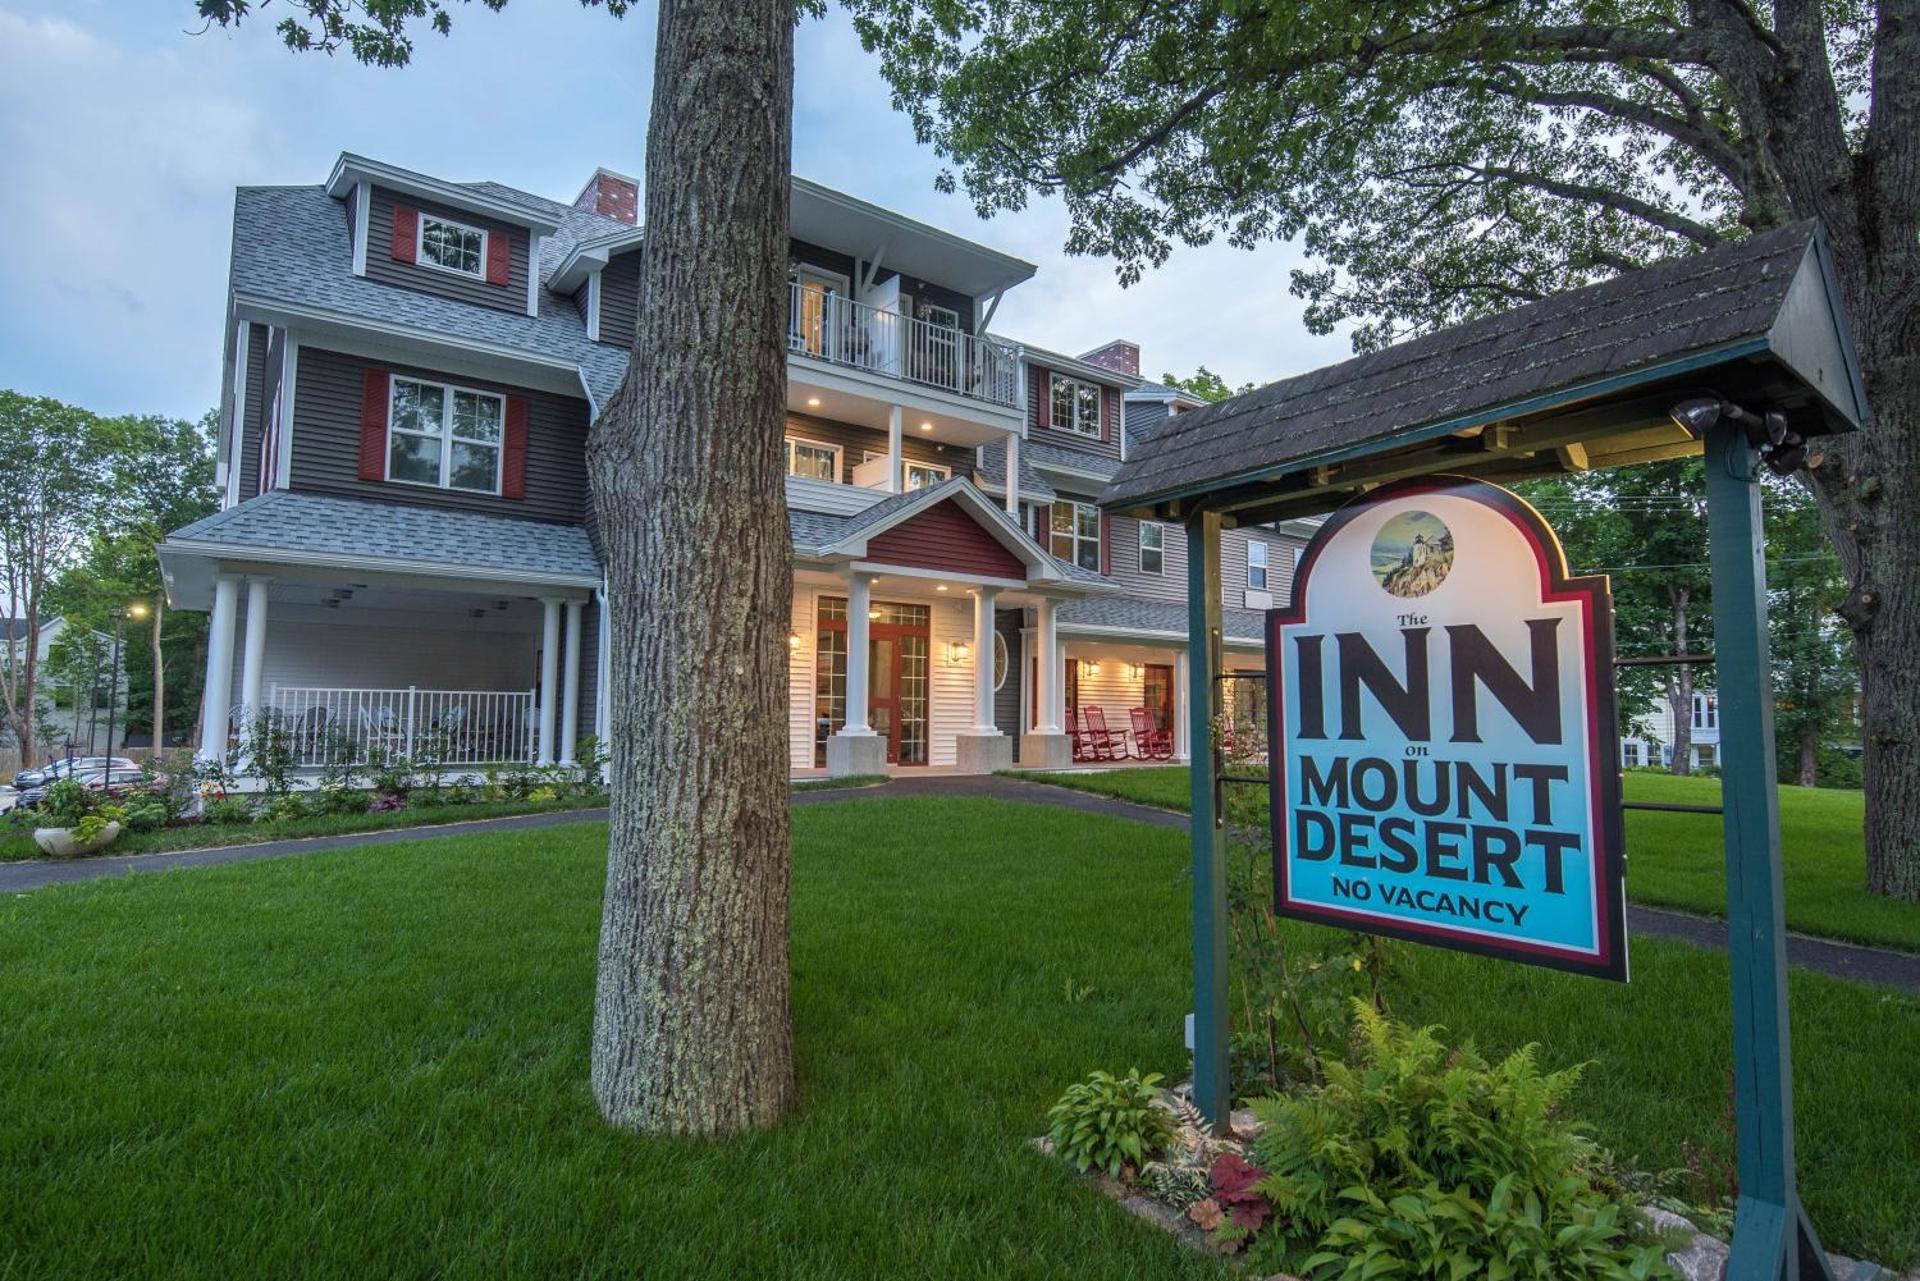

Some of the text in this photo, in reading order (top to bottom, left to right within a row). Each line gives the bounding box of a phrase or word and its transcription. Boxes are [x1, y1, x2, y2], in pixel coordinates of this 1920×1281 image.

[1397, 612, 1428, 627] The
[1294, 617, 1563, 745] INN
[1405, 744, 1430, 757] on
[1299, 755, 1569, 826] MOUNT
[1296, 808, 1581, 894] DESERT
[1332, 876, 1529, 927] NO VACANCY
